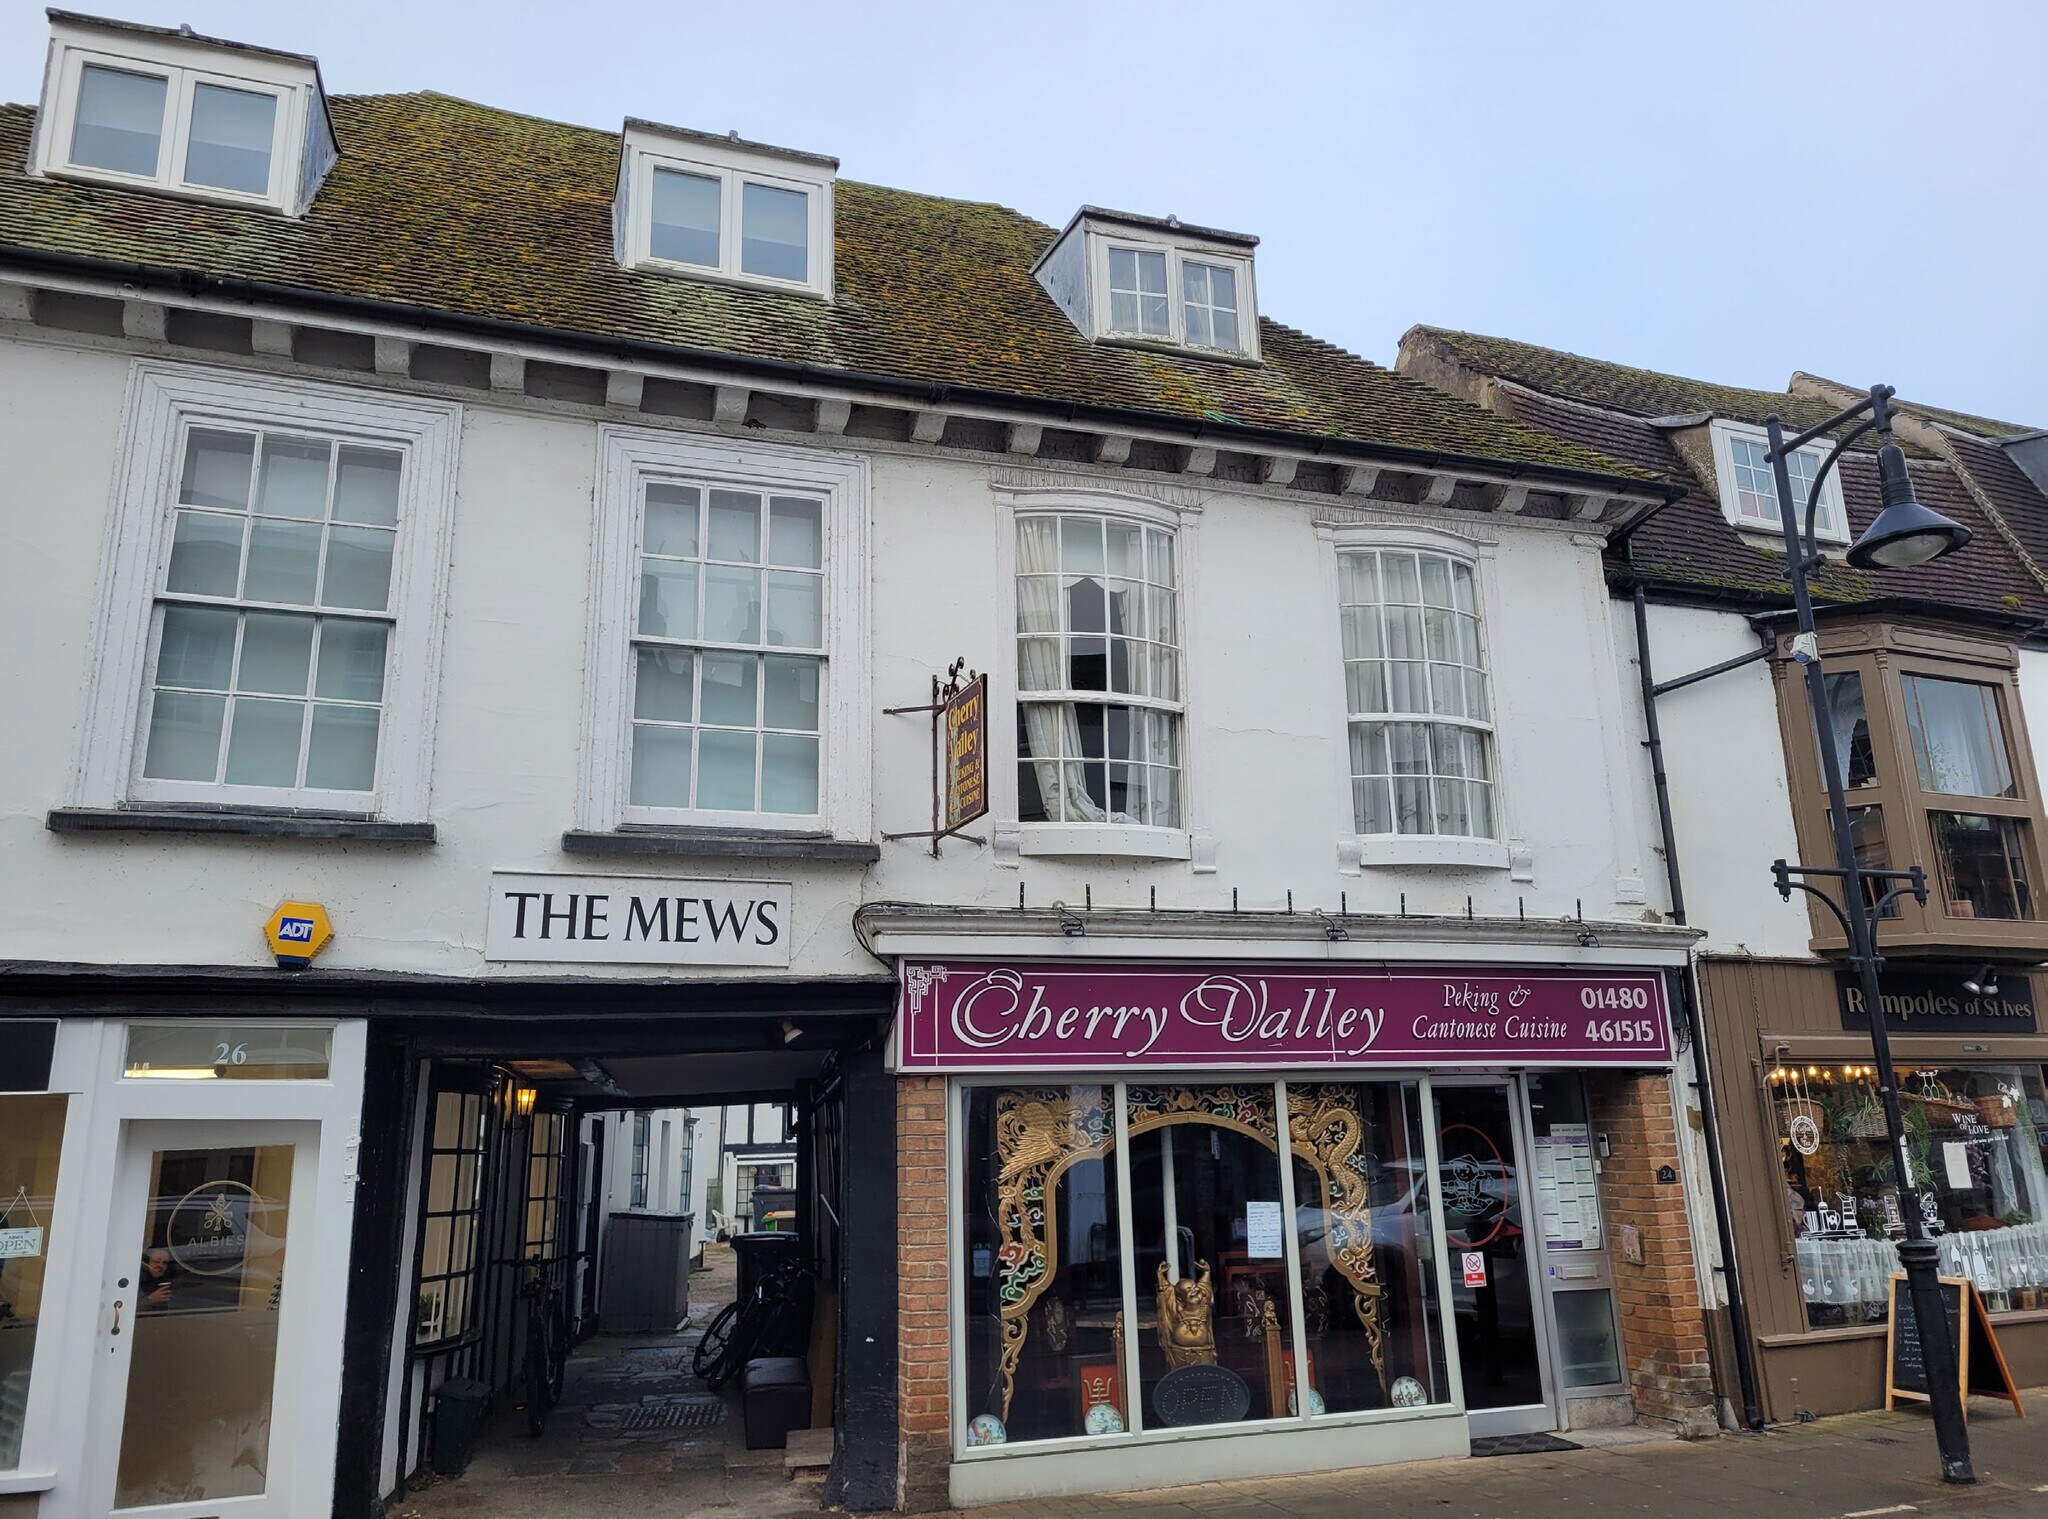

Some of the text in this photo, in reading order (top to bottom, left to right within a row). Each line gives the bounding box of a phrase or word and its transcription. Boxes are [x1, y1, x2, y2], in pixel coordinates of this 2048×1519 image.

[948, 694, 979, 731] Cherry
[278, 922, 313, 939] ADT
[505, 892, 779, 946] THE MEWS
[1443, 983, 1531, 1015] Peking &
[1580, 987, 1648, 1009] 01480
[1846, 987, 2032, 1020] Rmpoles of St Ives
[951, 968, 1385, 1057] Cherry Valley
[1411, 1015, 1567, 1039] Cantonese Cuisine
[1585, 1020, 1655, 1042] 461515
[214, 1042, 249, 1065] 26
[1952, 1113, 1977, 1124] WINE
[1968, 1125, 1990, 1134] LOVE
[1662, 1170, 1672, 1179] 24
[188, 1235, 245, 1248] ALBIES
[1162, 1386, 1238, 1415] OPEN
